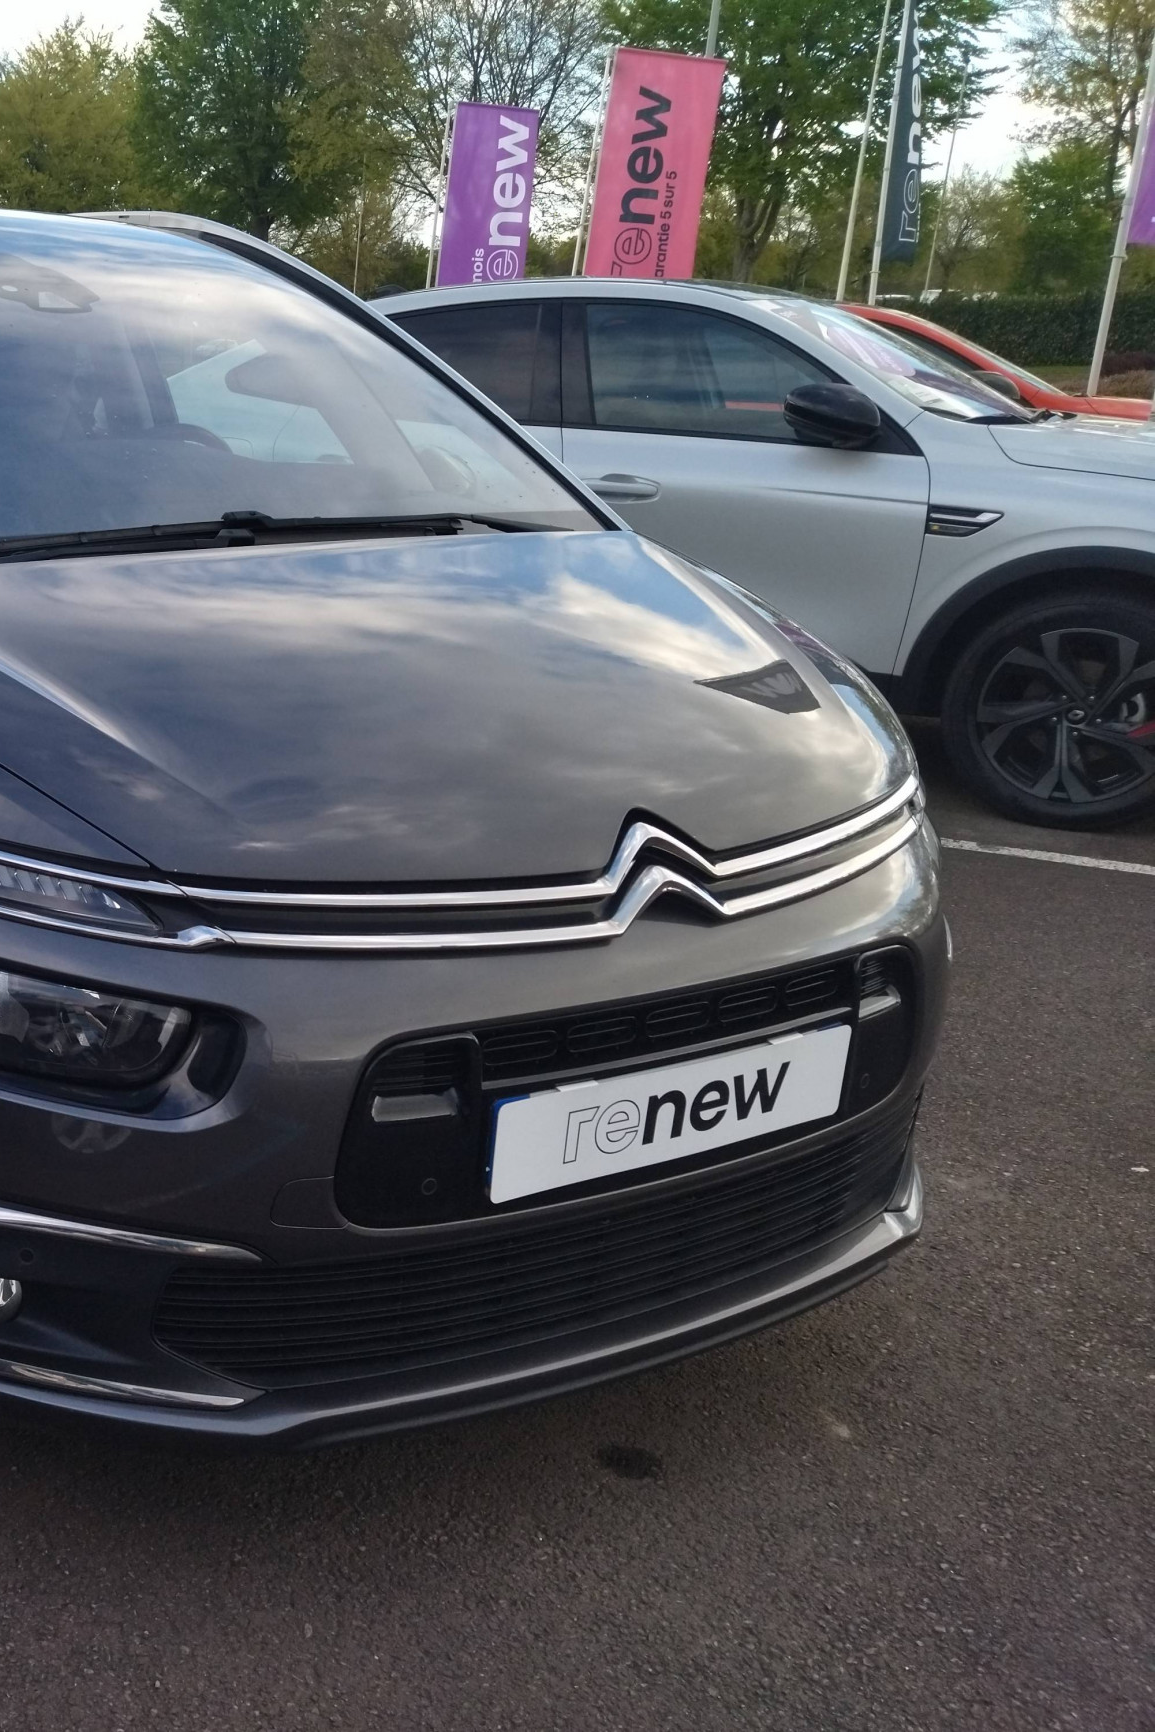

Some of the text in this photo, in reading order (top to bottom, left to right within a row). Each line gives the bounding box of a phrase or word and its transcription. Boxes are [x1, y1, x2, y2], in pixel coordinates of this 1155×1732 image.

[486, 114, 530, 281] enew
[654, 170, 678, 278] arantie 5 sur 5
[562, 1060, 791, 1165] renew
